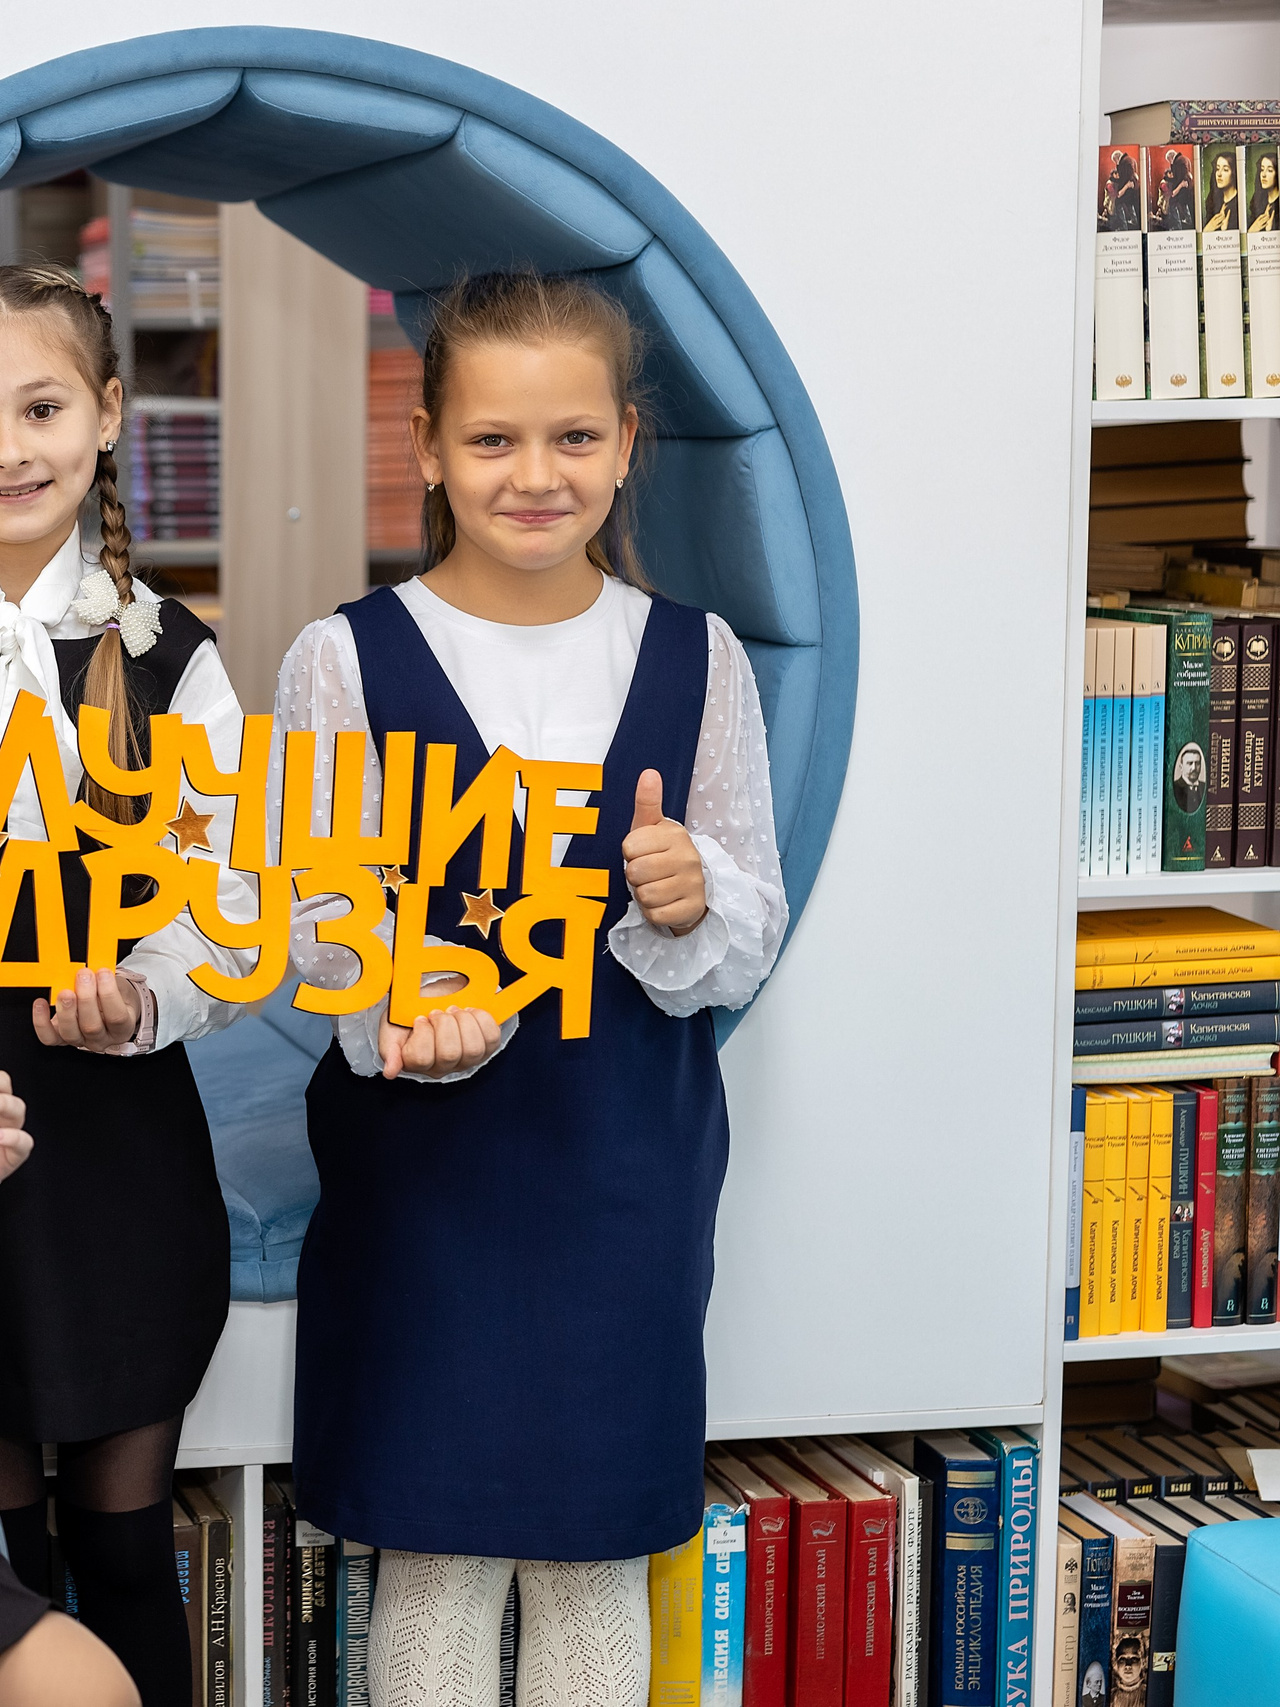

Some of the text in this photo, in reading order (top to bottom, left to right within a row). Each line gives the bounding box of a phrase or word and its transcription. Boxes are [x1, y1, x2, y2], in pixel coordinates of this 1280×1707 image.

[1111, 258, 1132, 266] Братья
[1174, 633, 1211, 652] КУПРИН
[1208, 732, 1222, 795] Александр
[1221, 738, 1231, 789] КУПРИН
[1241, 730, 1256, 794] Александр
[1254, 736, 1264, 787] КУПРИН
[1175, 942, 1256, 954] Капитанская дочка
[1190, 1001, 1219, 1011] дочка
[1191, 990, 1251, 1001] Капитанская
[1190, 1022, 1251, 1034] Капитанская
[1190, 1034, 1218, 1043] дочка
[1181, 1229, 1192, 1293] Капитанская
[1201, 1228, 1212, 1288] Дубровский
[723, 1530, 728, 1538] 6
[907, 1508, 916, 1548] ФЛОТЕ
[211, 1557, 228, 1647] А.Н.Краснов
[263, 1519, 276, 1646] ШКОЛЬНИКА
[347, 1558, 370, 1634] ШКОЛЬНИКА
[764, 1545, 776, 1656] ПРИМОРСКИЙ КРАЙ
[816, 1549, 827, 1660] ПРИМОРСКИЙ КРАЙ
[865, 1547, 877, 1657] ПРИМОРСКИЙ КРАЙ
[907, 1551, 915, 1605] РУССКОМ
[1006, 1456, 1036, 1707] УКА ПРИРОДЫ
[905, 1621, 914, 1681] РАССКАЗЫ
[954, 1565, 967, 1690] БОЛЬШАЯ РОССИЙСКАЯ
[968, 1565, 983, 1691] ЭНЦИКЛОПЕДИЯ
[307, 1640, 316, 1707] ИСТОРИЯ ВОЙН
